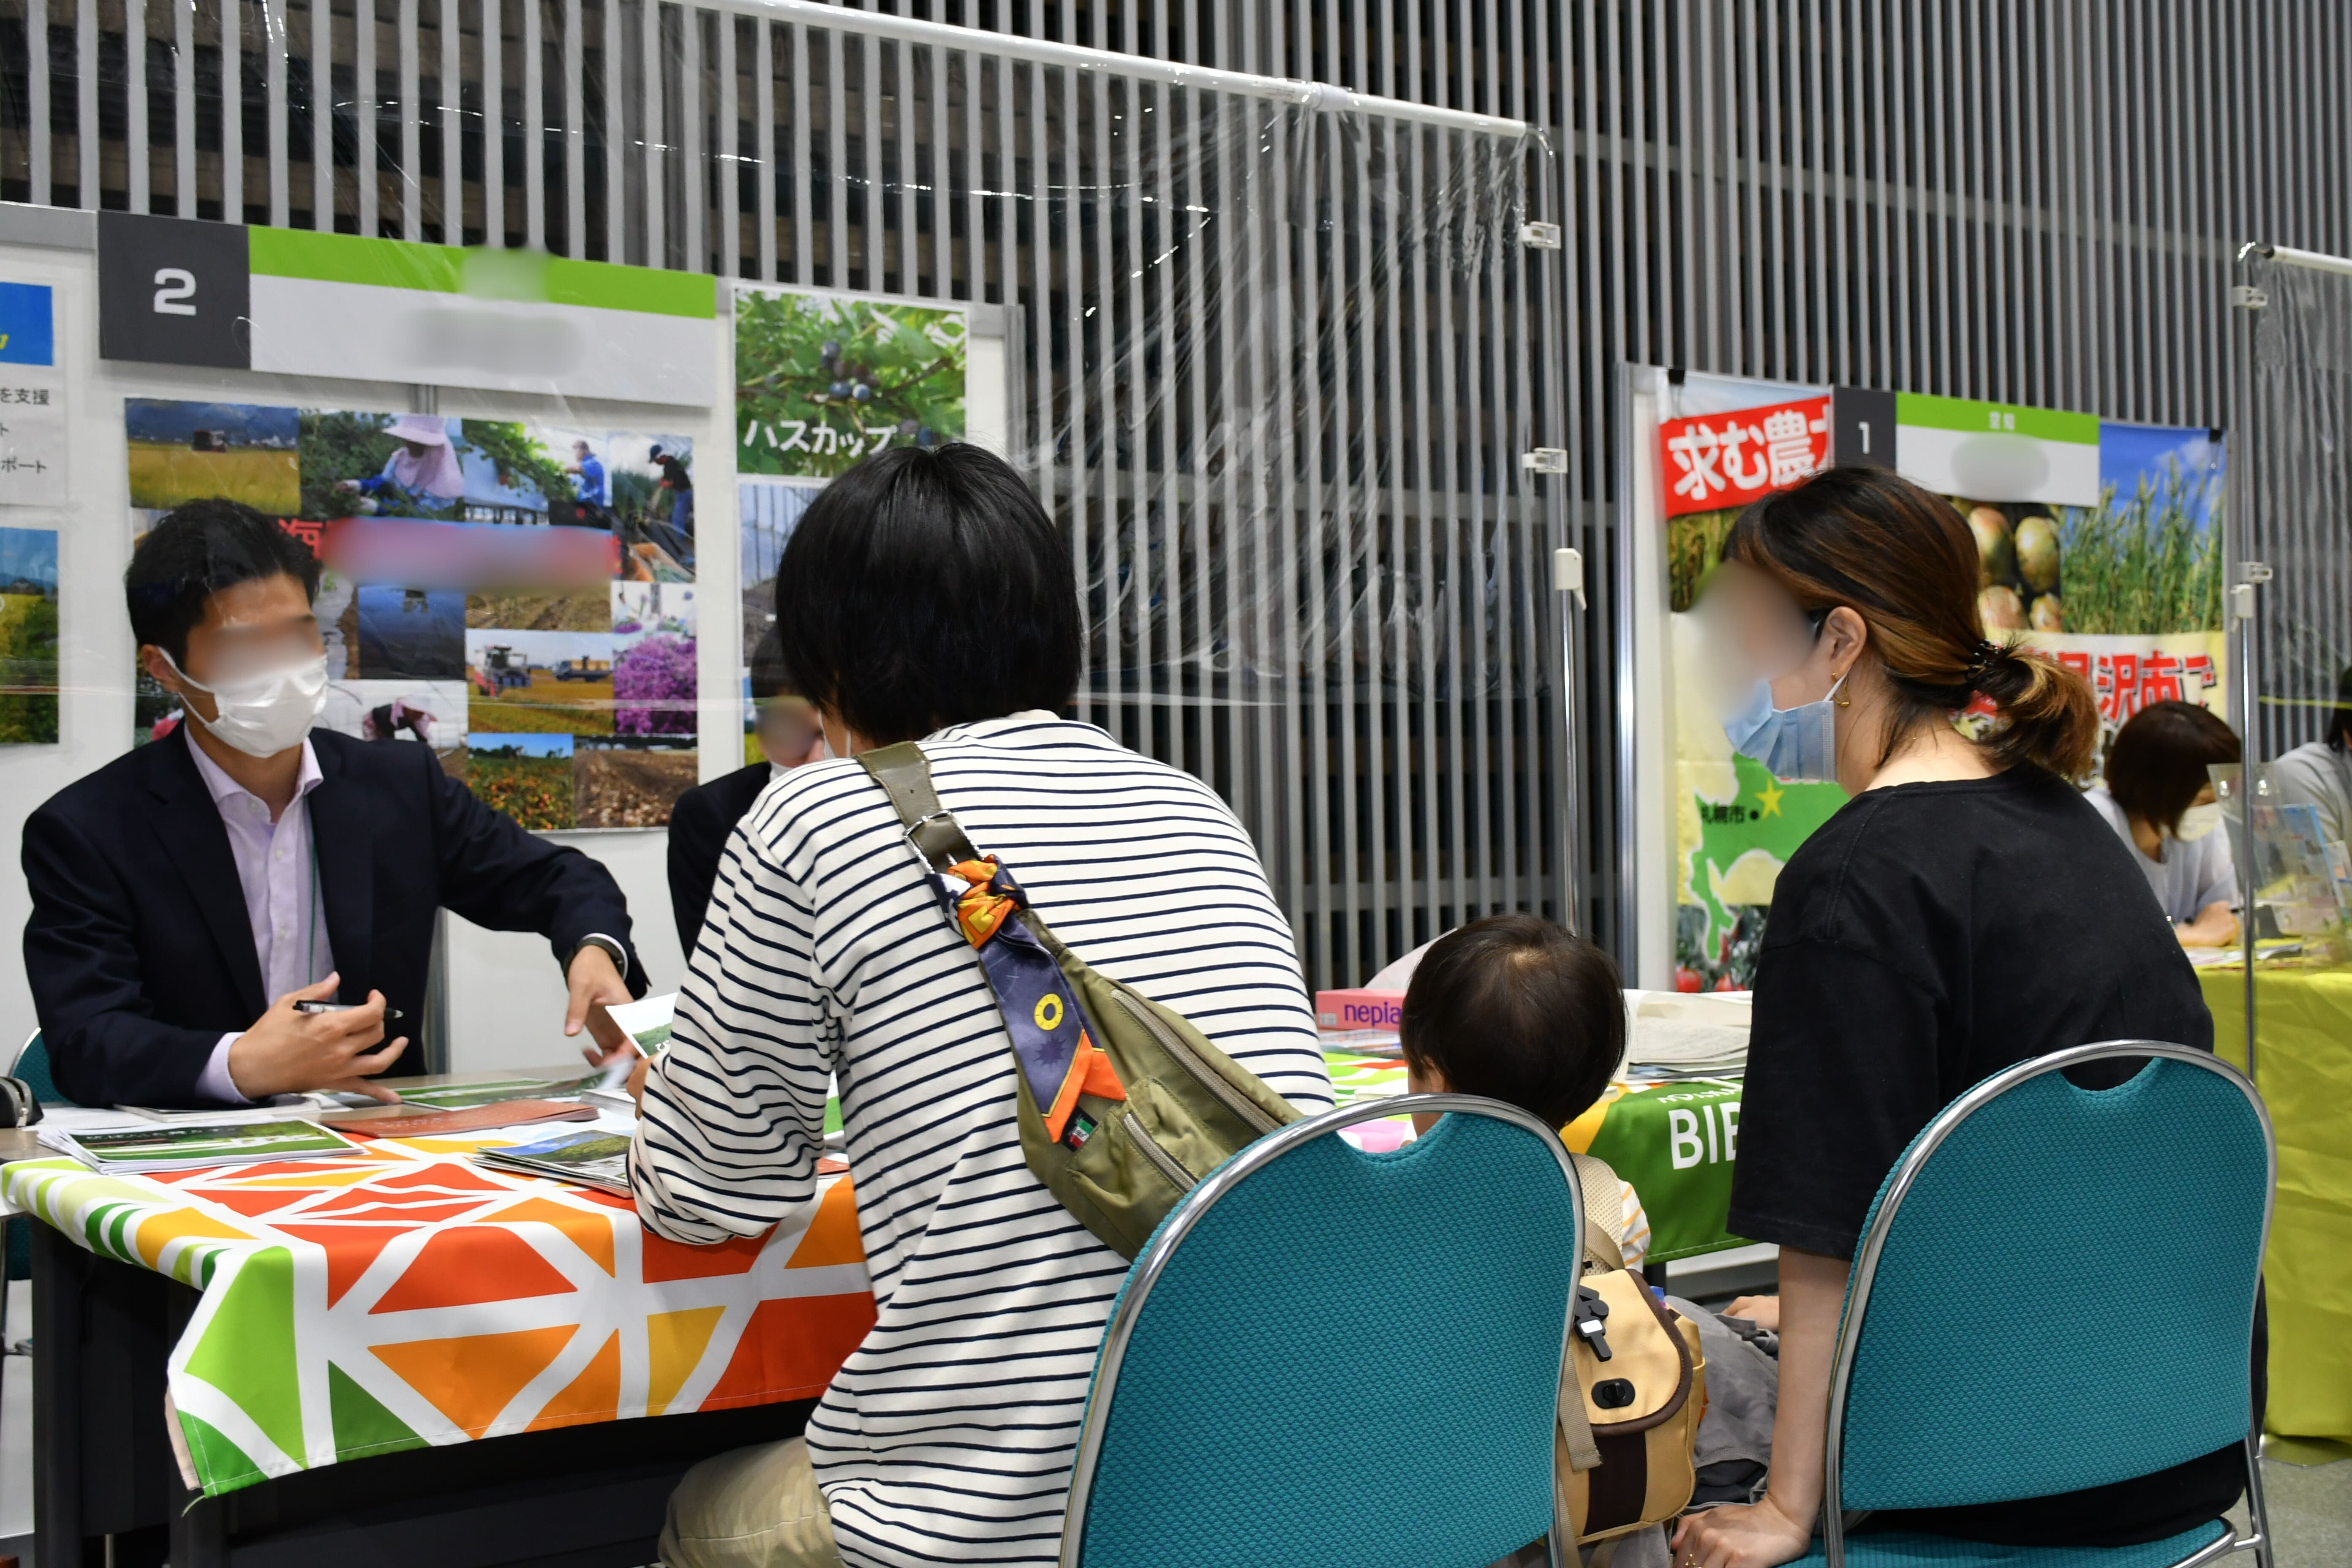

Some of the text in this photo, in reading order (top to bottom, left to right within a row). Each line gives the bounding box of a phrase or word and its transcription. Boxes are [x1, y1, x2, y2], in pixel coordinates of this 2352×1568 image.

[154, 268, 197, 316] 2
[743, 420, 898, 459] ハスカップ
[1859, 422, 1870, 455] 1
[1344, 1001, 1402, 1027] nepia
